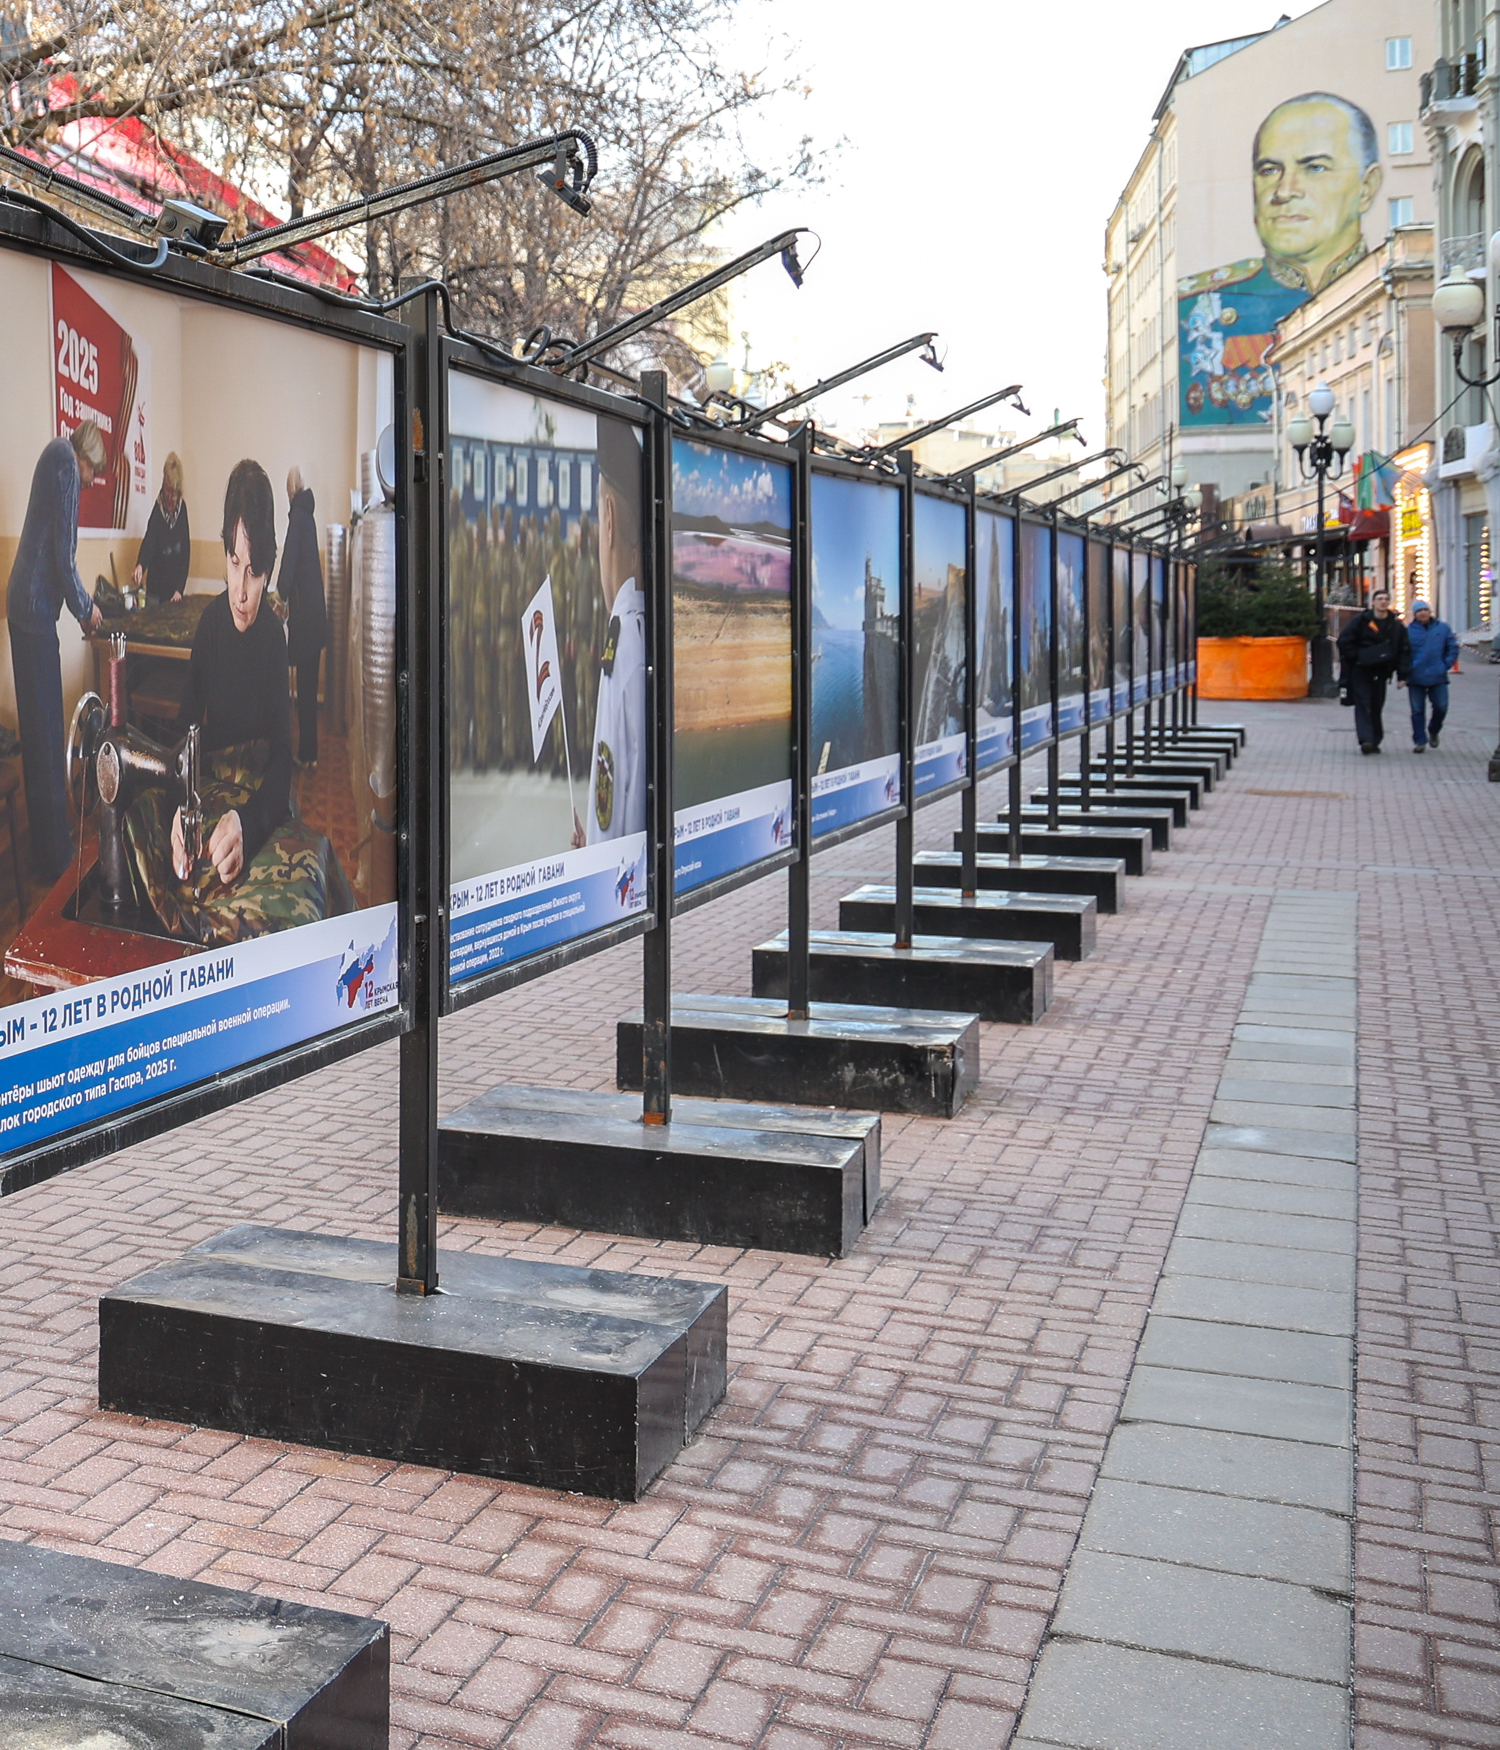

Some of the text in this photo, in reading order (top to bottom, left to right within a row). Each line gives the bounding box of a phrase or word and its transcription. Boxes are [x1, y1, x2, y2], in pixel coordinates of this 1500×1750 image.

[57, 319, 99, 395] 2025
[60, 386, 74, 419] Год
[475, 885, 483, 902] 12
[484, 880, 498, 900] ЛЕТ
[500, 879, 505, 895] В
[506, 866, 535, 892] РОДНОЙ
[538, 862, 564, 883] ГАВАНИ
[41, 1007, 57, 1034] 12
[61, 997, 92, 1028] ЛЕТ
[97, 993, 106, 1017] В
[111, 968, 172, 1013] РОДНОЙ
[180, 957, 233, 992] ГАВАНИ
[365, 981, 374, 998] 12
[36, 1072, 65, 1094] шьют
[67, 1059, 105, 1084] одежду
[107, 1052, 125, 1072] для
[126, 1041, 160, 1063] бойцов
[161, 1019, 217, 1050] специальной
[218, 1007, 251, 1032] военной
[252, 998, 290, 1020] операции.
[22, 1091, 82, 1124] городского
[84, 1083, 106, 1102] типа
[108, 1071, 143, 1093] Гаспра,
[145, 1058, 168, 1080] 2025
[169, 1059, 177, 1071] г.
